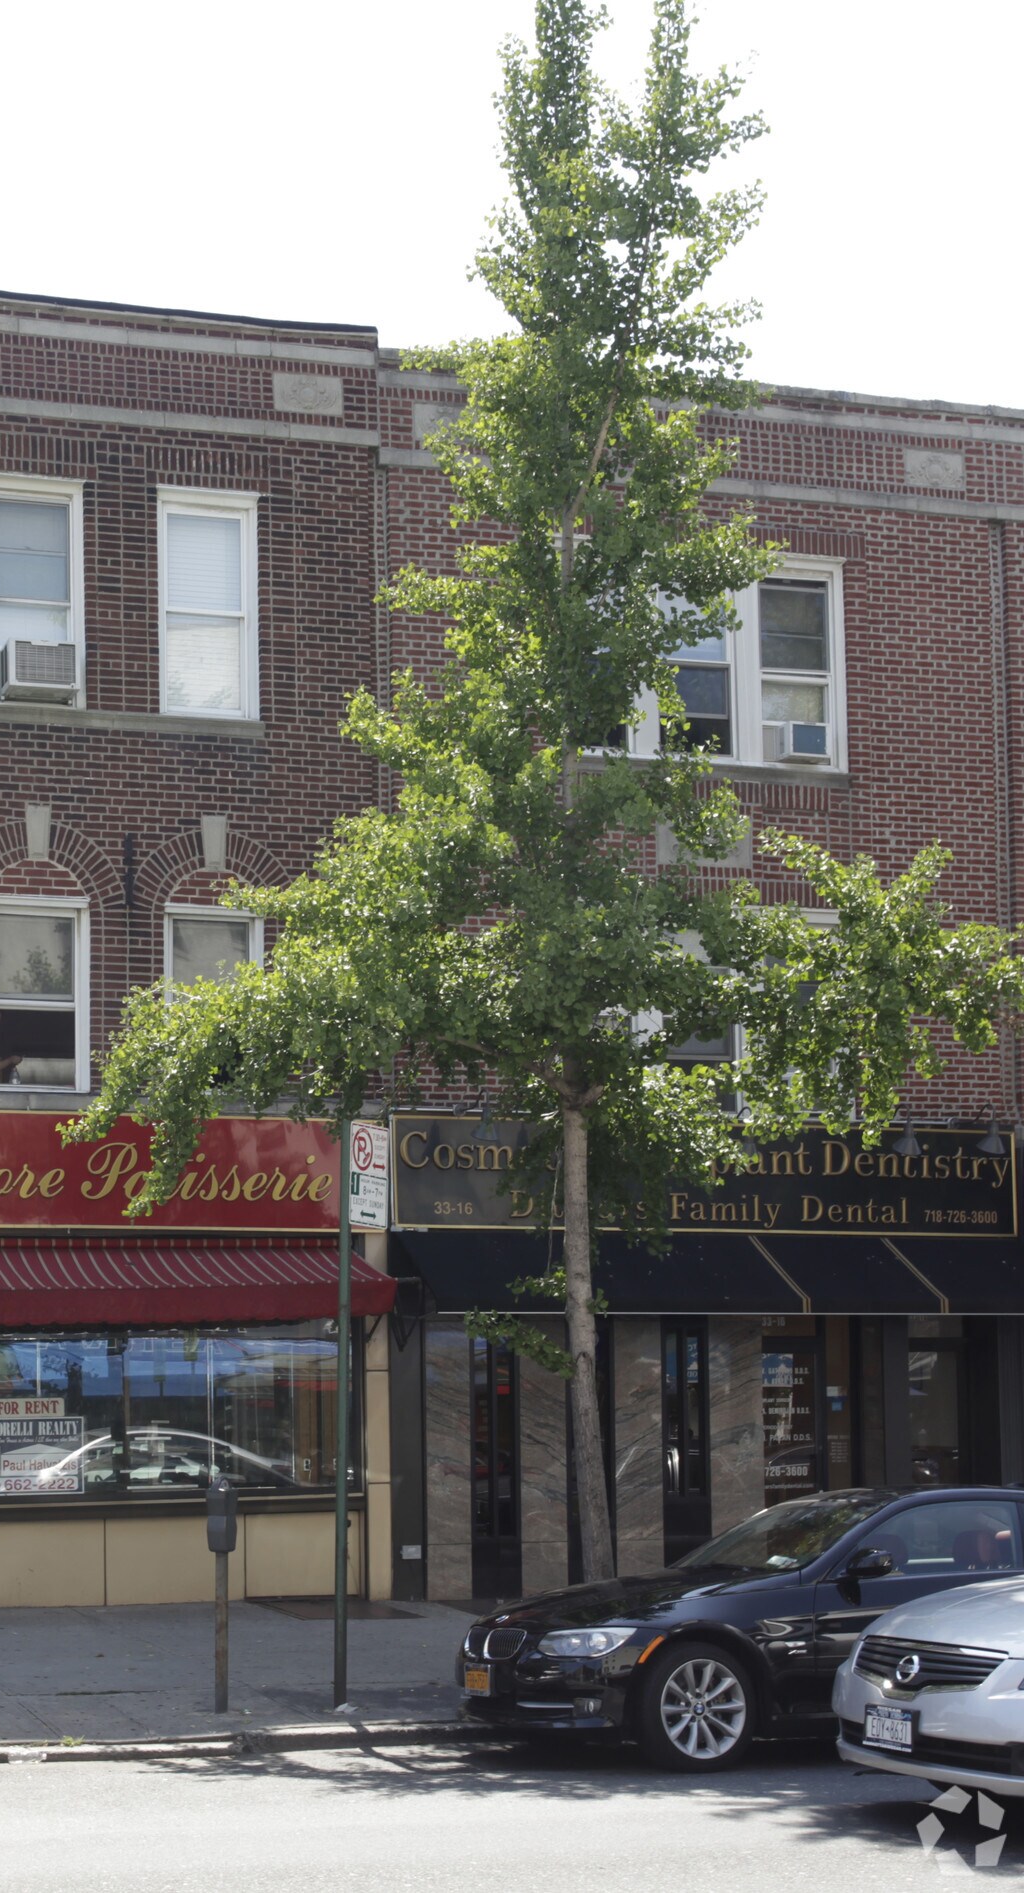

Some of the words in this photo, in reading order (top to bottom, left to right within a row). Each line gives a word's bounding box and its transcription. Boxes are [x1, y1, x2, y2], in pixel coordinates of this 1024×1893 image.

[80, 1142, 334, 1202] Paisserie
[821, 1141, 1012, 1188] Dentistry
[434, 1202, 473, 1215] 33-16
[669, 1192, 782, 1228] Family
[801, 1195, 910, 1225] Dental
[924, 1209, 998, 1224] 718-726-3600
[25, 1400, 59, 1414] RENT
[38, 1420, 79, 1436] REALTY
[2, 1460, 26, 1471] Paul
[29, 1460, 77, 1471] Halvazis
[4, 1478, 75, 1491] 662-2222
